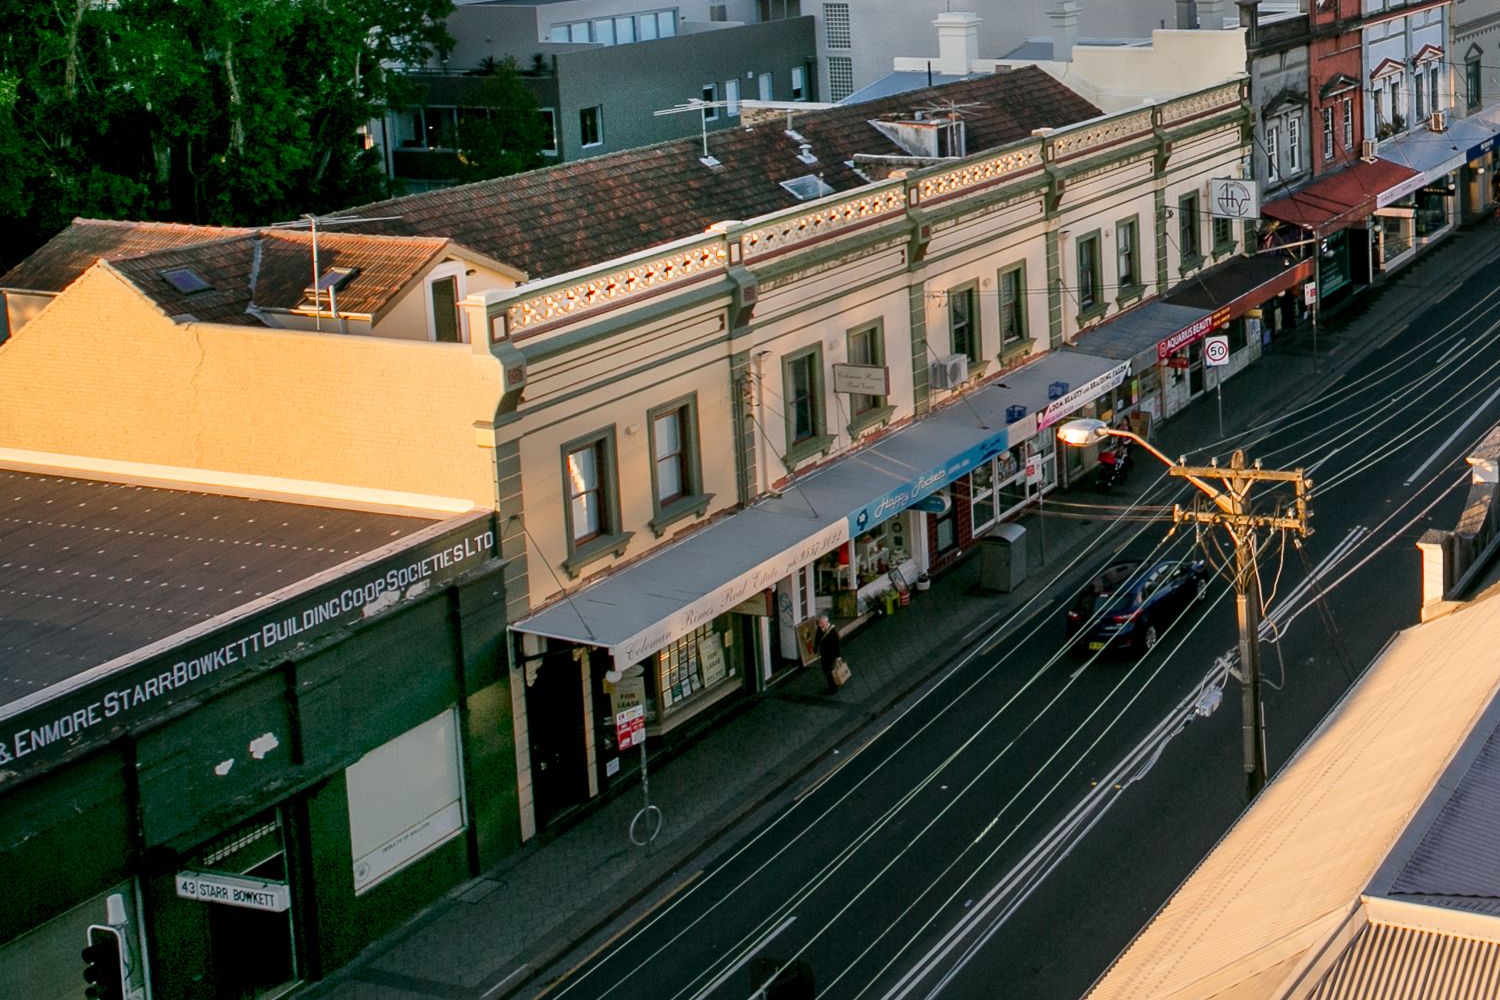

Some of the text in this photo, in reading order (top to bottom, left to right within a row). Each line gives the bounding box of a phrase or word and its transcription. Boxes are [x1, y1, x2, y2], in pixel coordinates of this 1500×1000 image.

[1192, 316, 1213, 334] BEAUTY
[1210, 346, 1225, 357] 50
[1064, 389, 1083, 406] BEAUTY
[874, 493, 910, 519] Happy
[720, 579, 748, 608] Real
[750, 566, 778, 589] Estate
[14, 702, 102, 758] ENMORE
[386, 544, 464, 592] SOCIETIES
[464, 531, 494, 558] LTD
[617, 700, 640, 709] LEASE
[620, 692, 636, 700] FOR
[181, 881, 275, 907] 43 STARR BOWKETT
